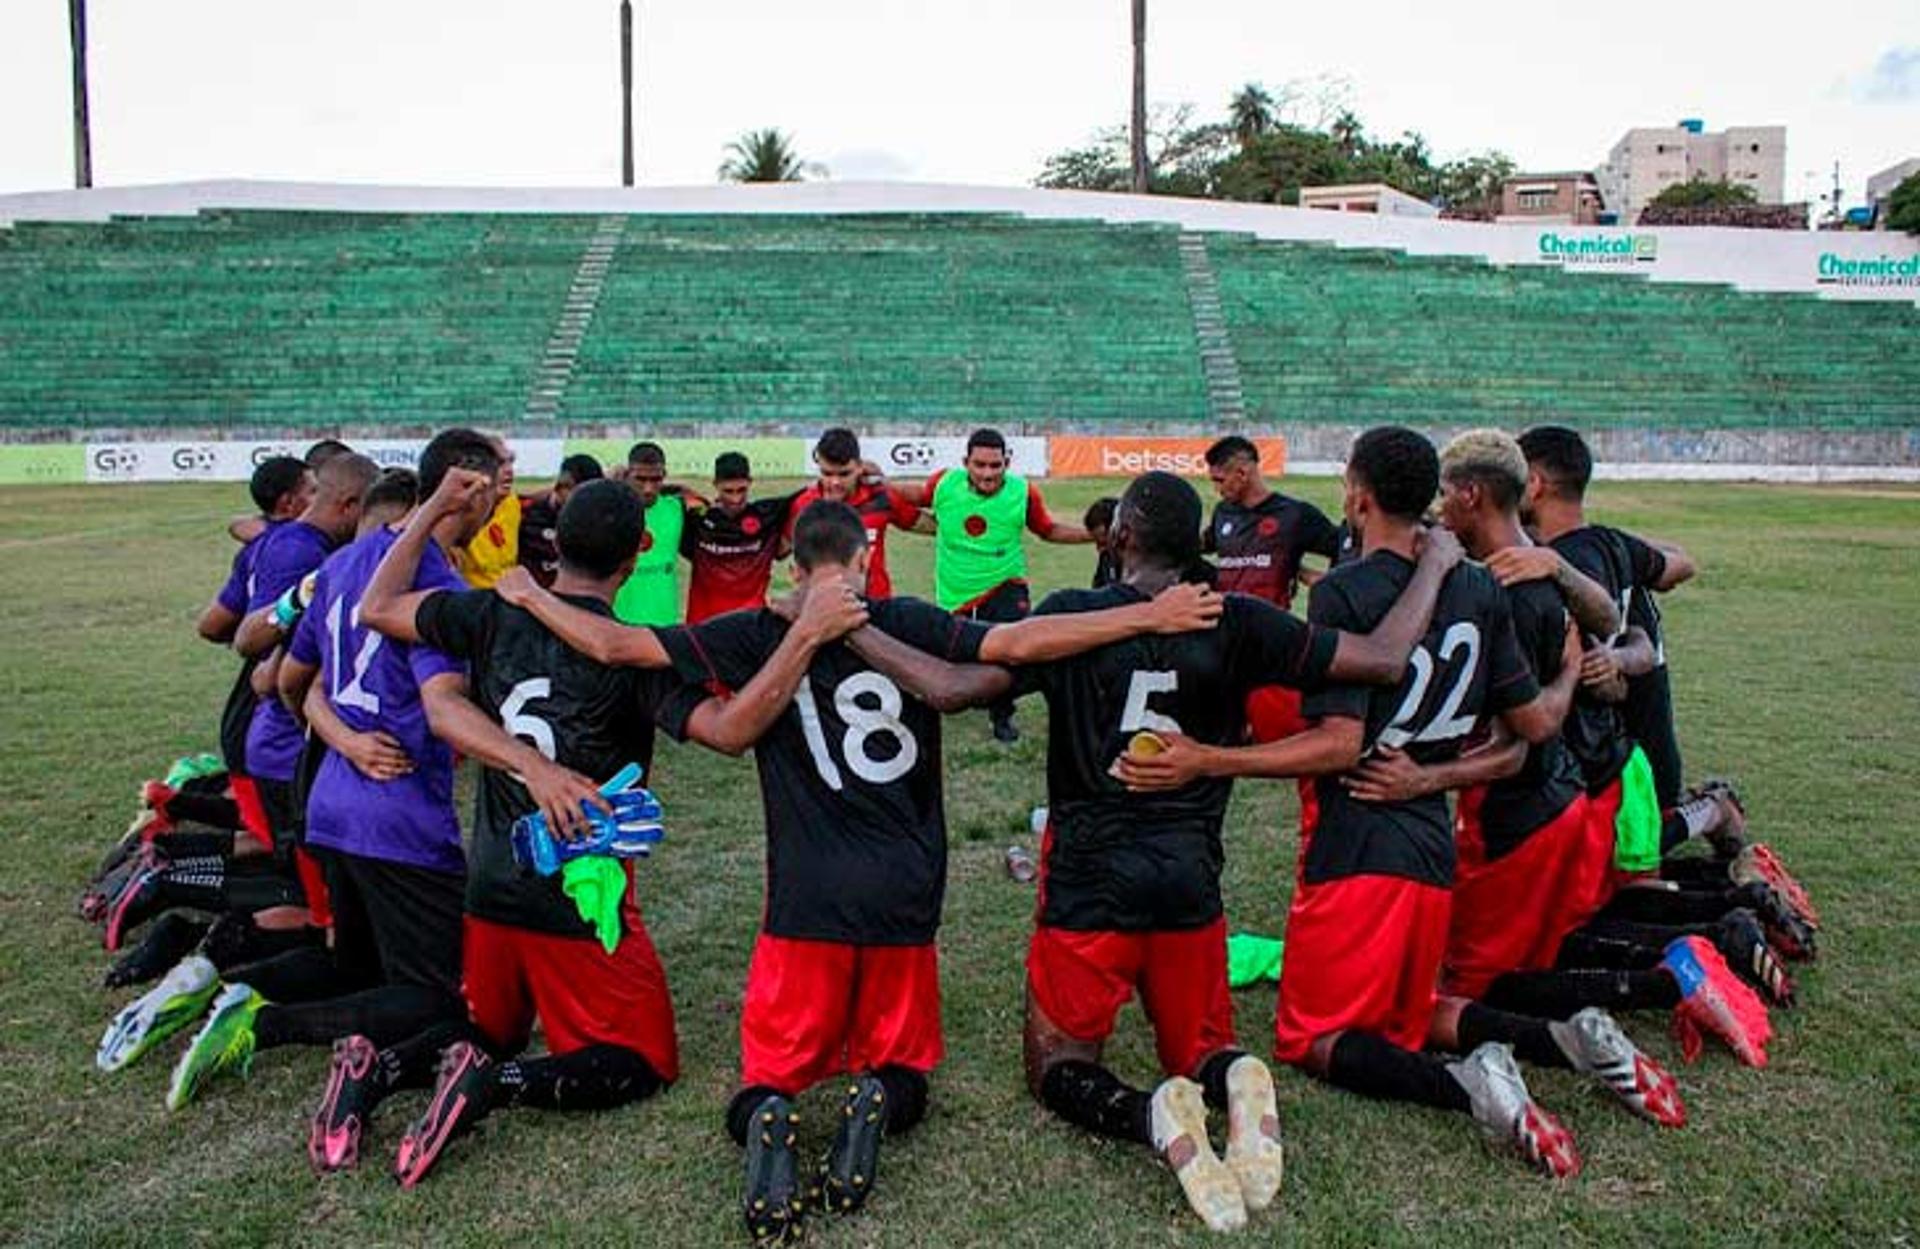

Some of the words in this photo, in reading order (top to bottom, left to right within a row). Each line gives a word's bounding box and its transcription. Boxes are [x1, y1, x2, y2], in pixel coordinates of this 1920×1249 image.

[1539, 233, 1632, 253] Chemical
[1818, 252, 1919, 275] Chemical
[1102, 447, 1209, 472] betsso
[1370, 621, 1481, 749] 22
[794, 669, 918, 790] 18
